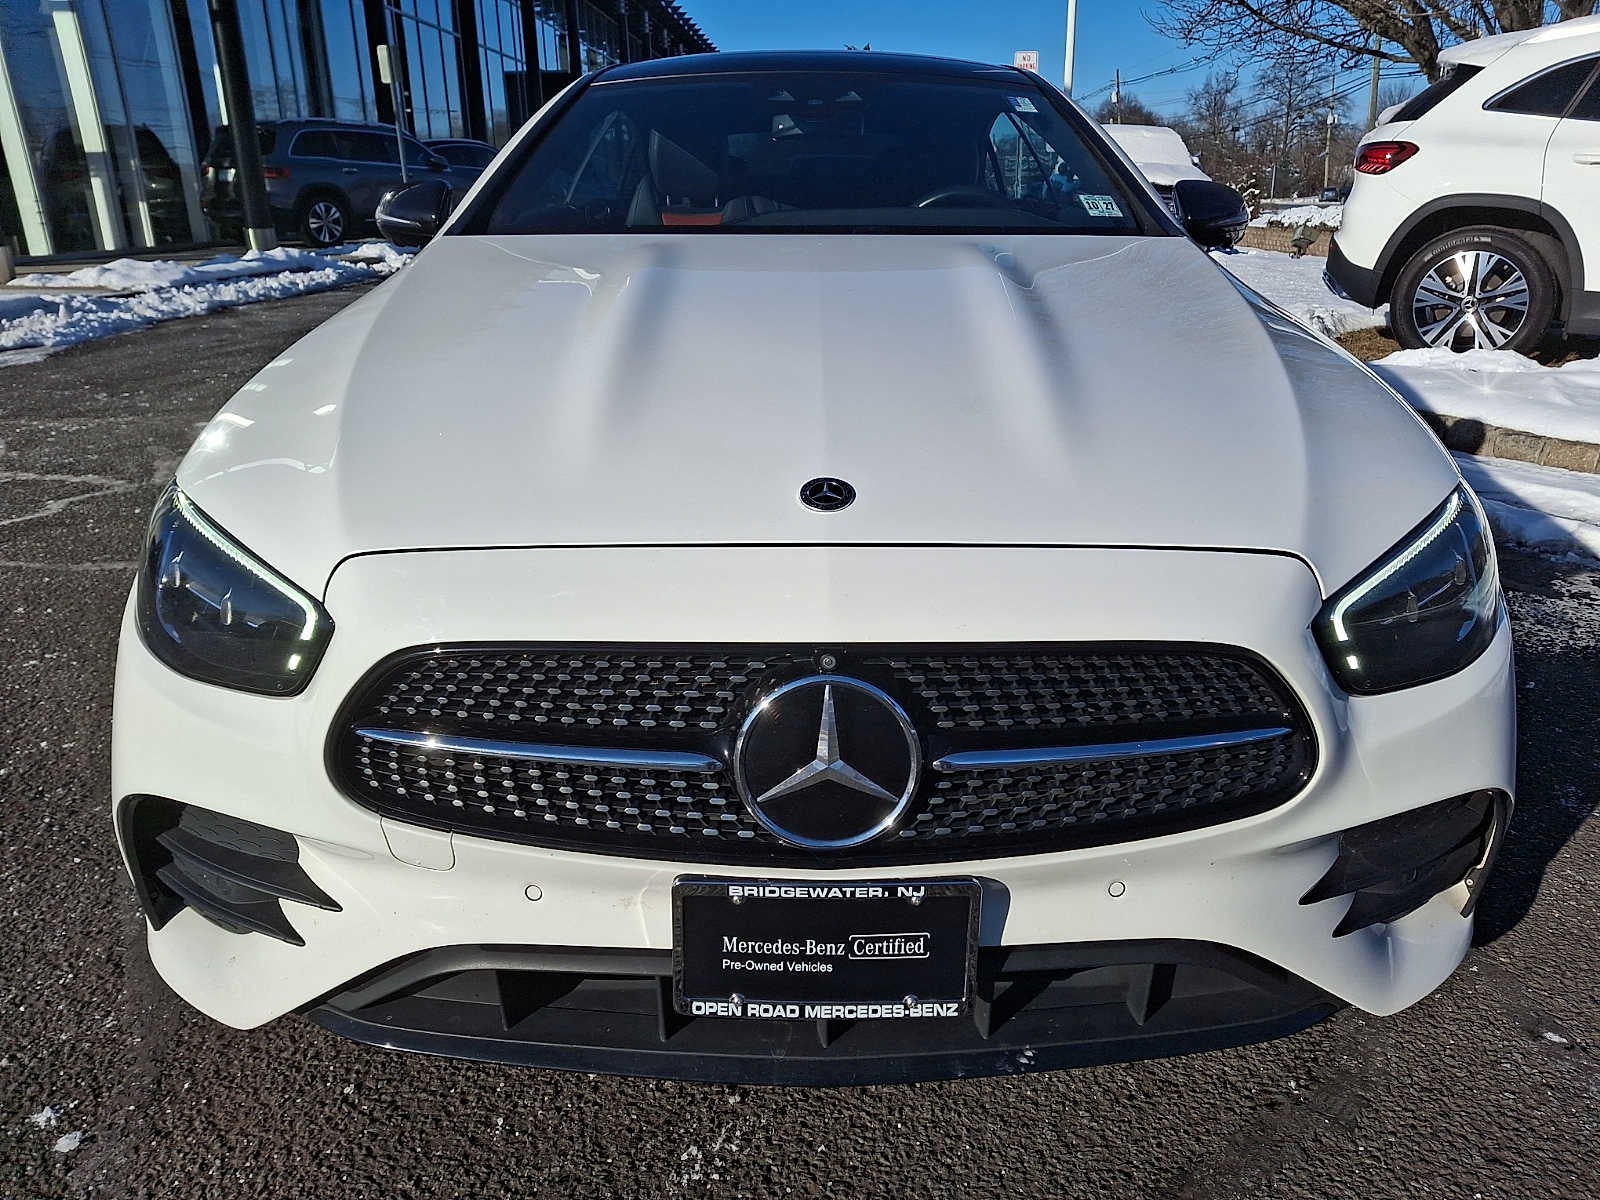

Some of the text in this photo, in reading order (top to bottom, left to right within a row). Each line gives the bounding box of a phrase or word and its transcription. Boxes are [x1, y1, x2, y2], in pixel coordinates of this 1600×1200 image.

[1086, 201, 1115, 211] 10 27
[728, 885, 925, 898] BRIDGEWATER, NJ
[722, 936, 925, 956] Mercedes-Benz Certified
[722, 959, 833, 973] Pre-Owned Vehicles
[691, 1001, 959, 1019] OPEN ROAD MERCEDES-BENZ
